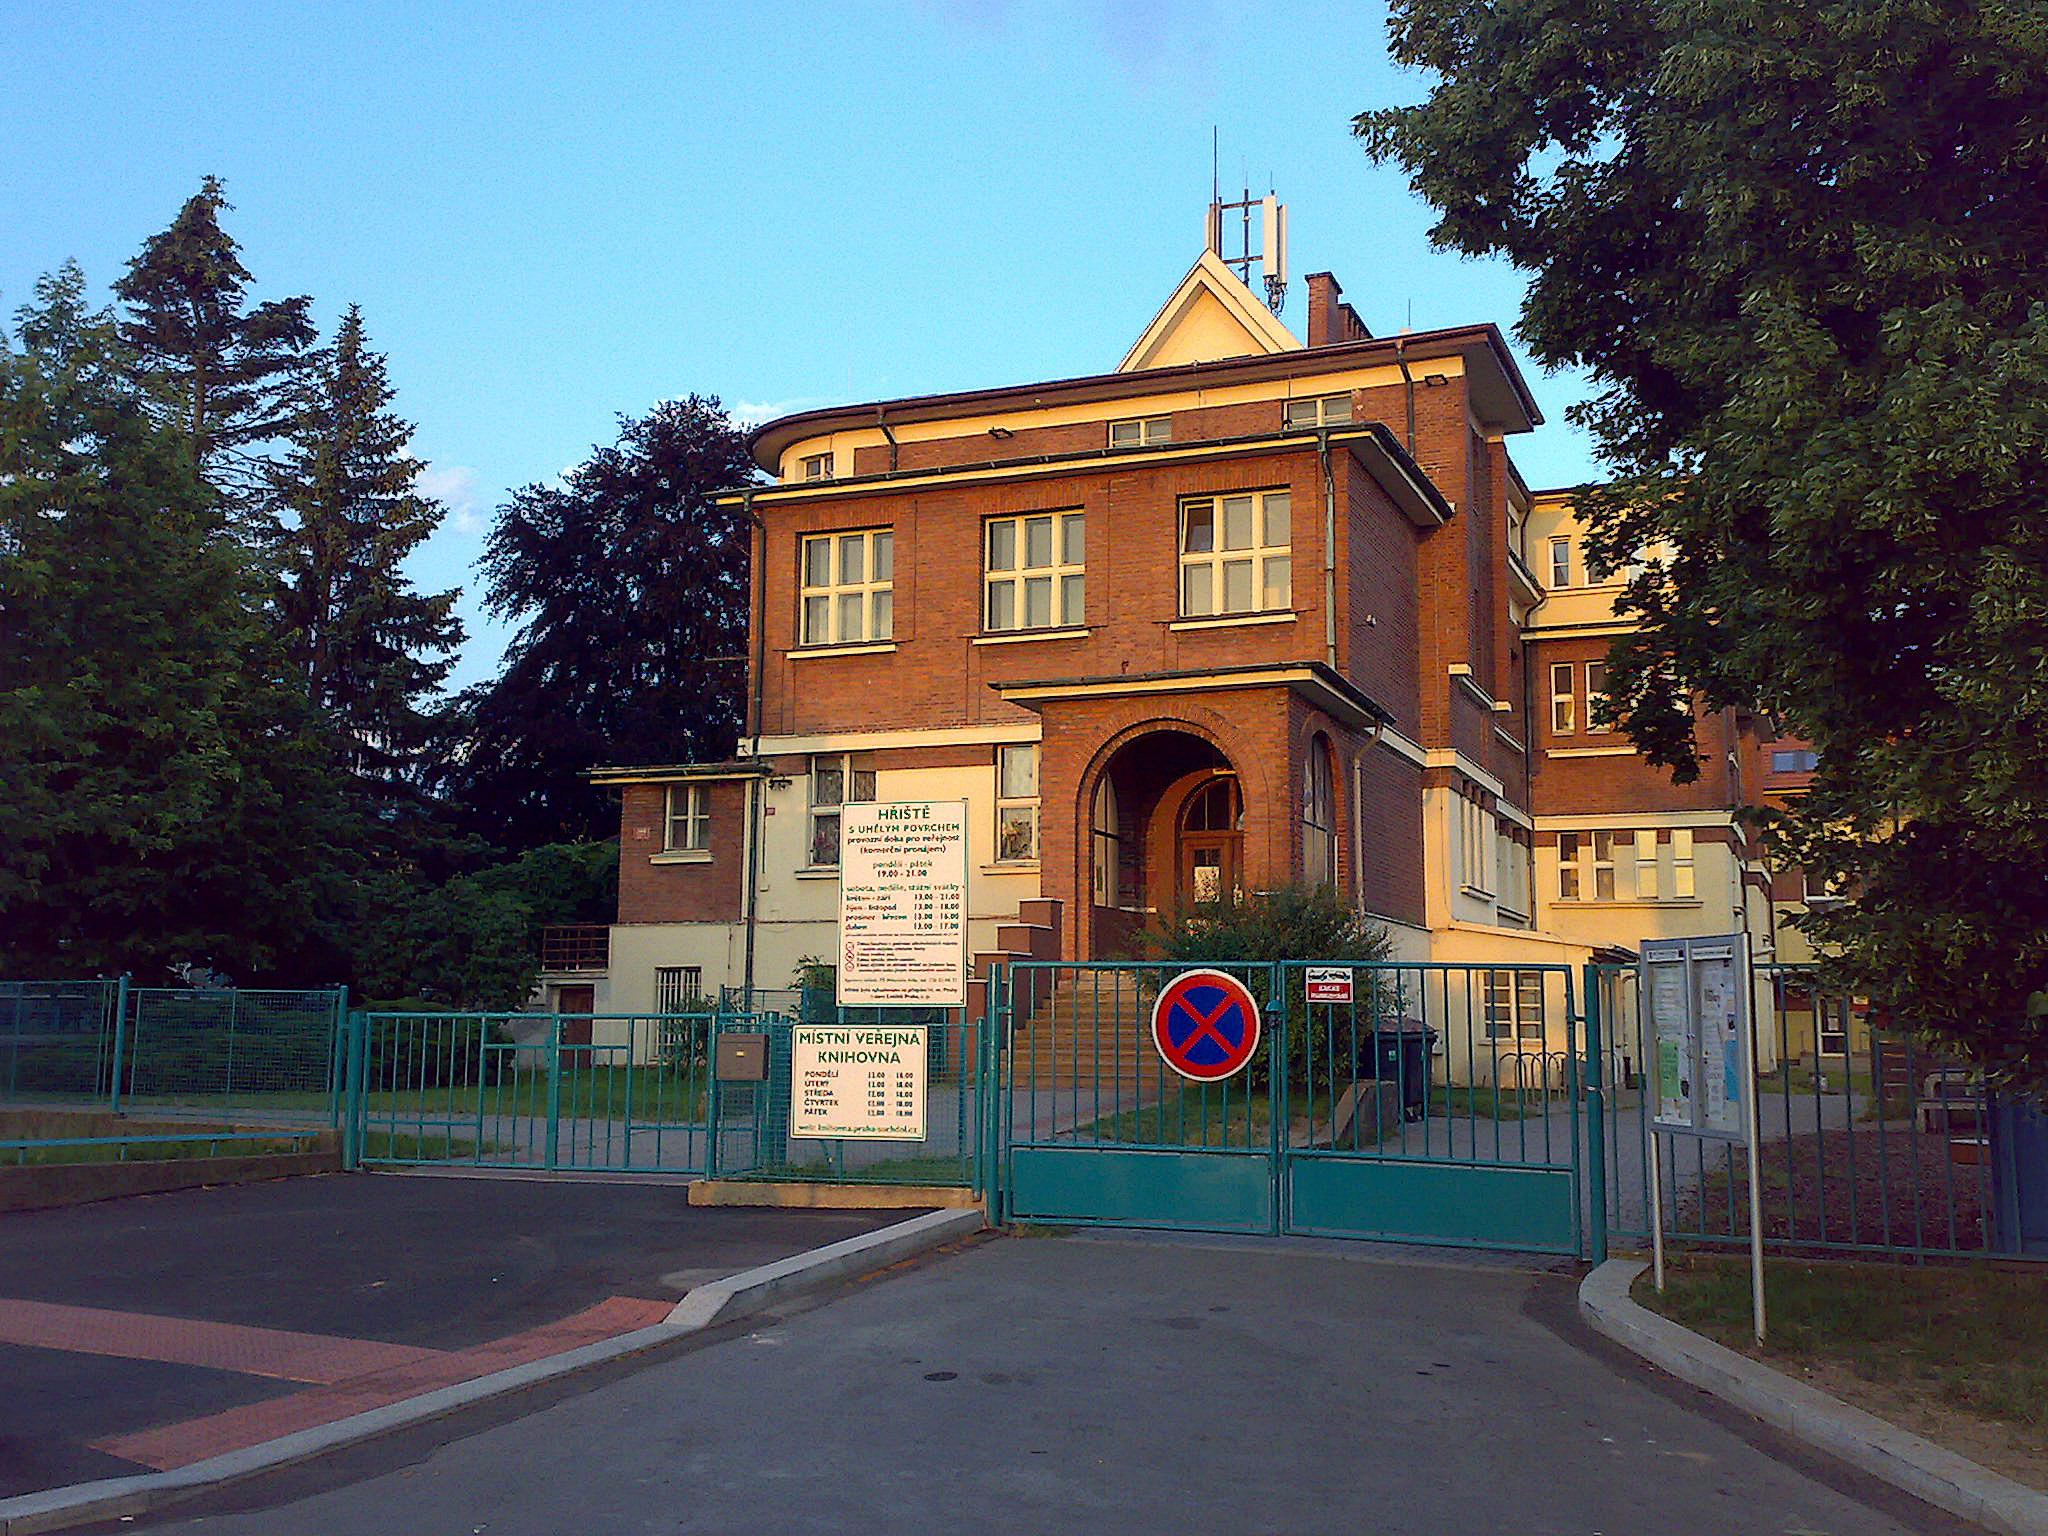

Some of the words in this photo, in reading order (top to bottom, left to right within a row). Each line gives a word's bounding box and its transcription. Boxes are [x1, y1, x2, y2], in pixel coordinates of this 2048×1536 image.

[878, 805, 930, 820] HŘIŠTĚ
[848, 825, 855, 834] S
[904, 823, 960, 832] POVRCHEM
[905, 836, 920, 844] pro
[906, 869, 928, 877] 21.00
[799, 1029, 850, 1044] MÍSTNÍ
[856, 1029, 921, 1048] VEŘEJNÁ
[818, 1051, 901, 1064] KNIHOVNA
[804, 1069, 839, 1078] PONDĚLÍ
[804, 1098, 839, 1106] ČTVRTEK
